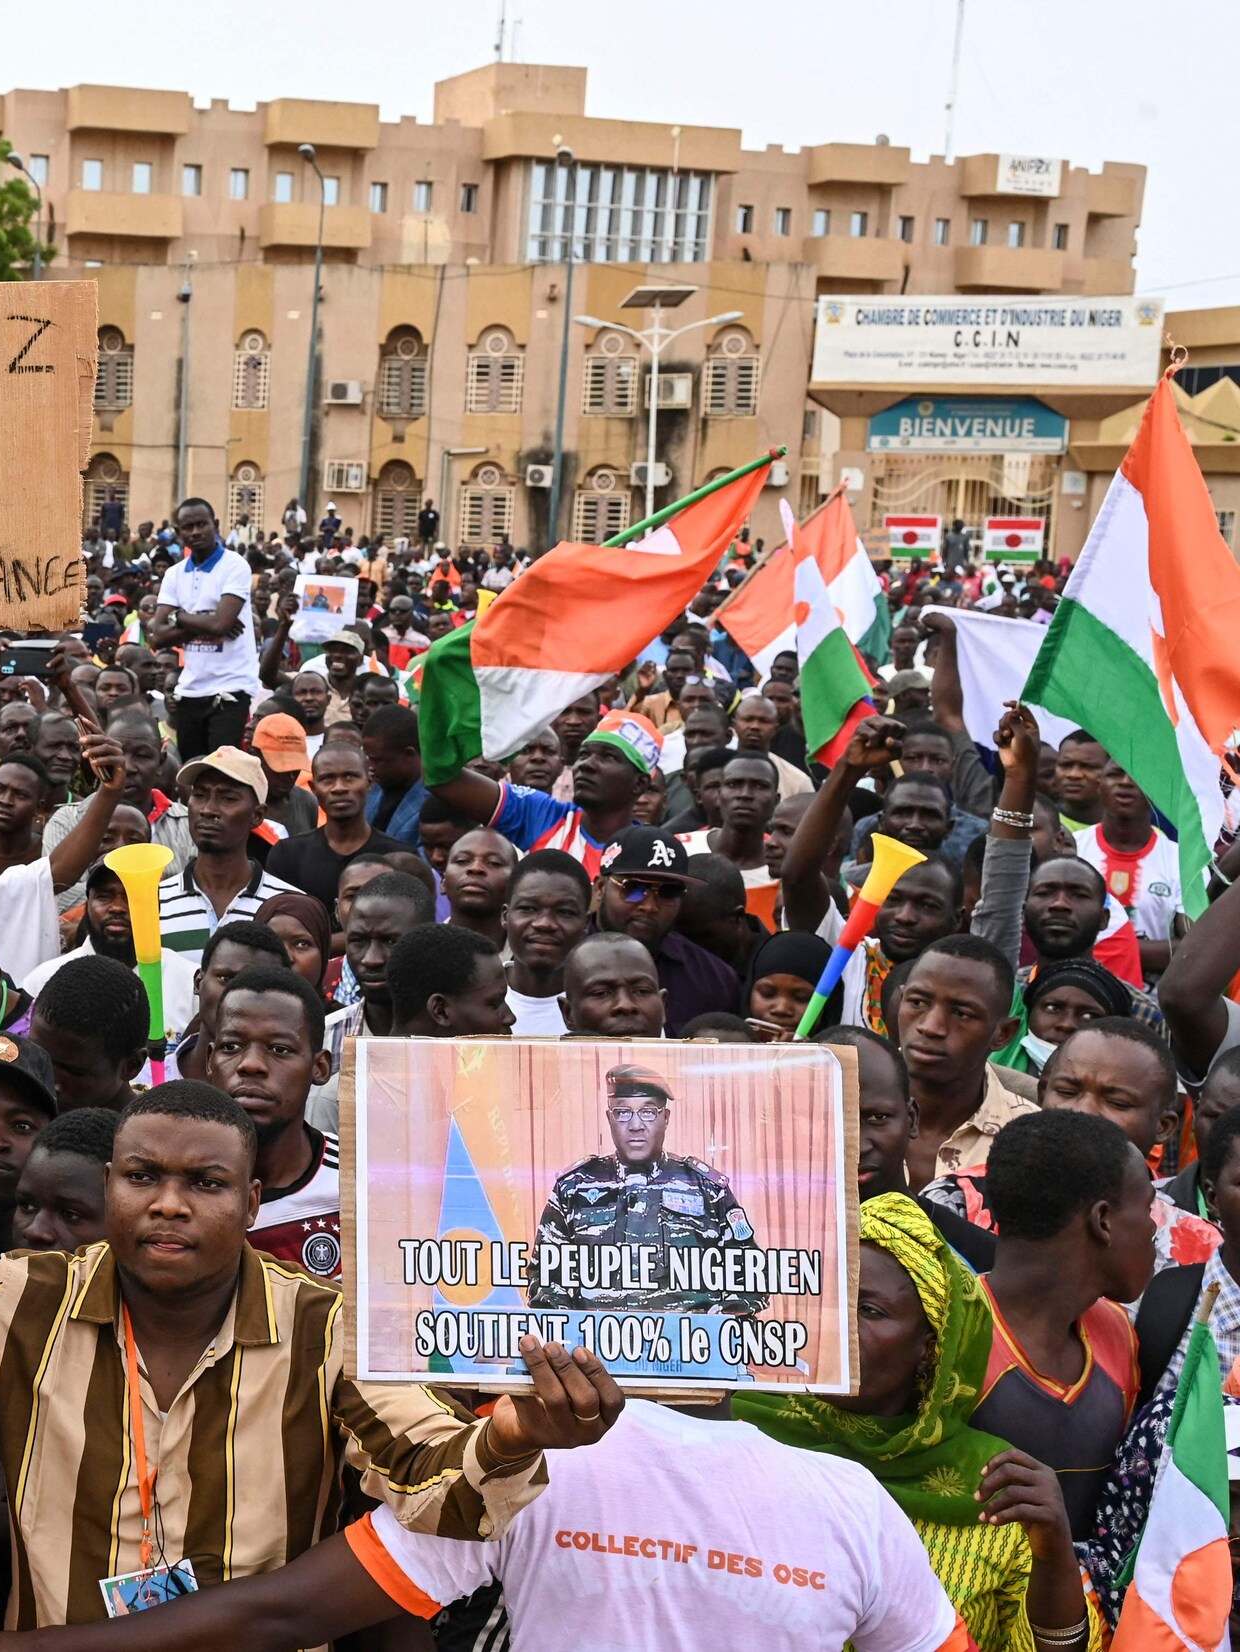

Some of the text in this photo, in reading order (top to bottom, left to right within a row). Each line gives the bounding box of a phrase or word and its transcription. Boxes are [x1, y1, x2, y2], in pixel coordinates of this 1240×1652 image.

[855, 308, 1123, 327] CHAMBRE DE COMMERCE ET D'INDUSTRIE DU NIGER
[899, 417, 1035, 438] BIENVENUE
[398, 1239, 822, 1296] TOUT LE PEUPLE NIGERIEN
[579, 1312, 671, 1363] 100%
[681, 1317, 710, 1364] le
[718, 1319, 808, 1367] CNSP
[555, 1530, 826, 1590] COLLECTIF DES OSC
